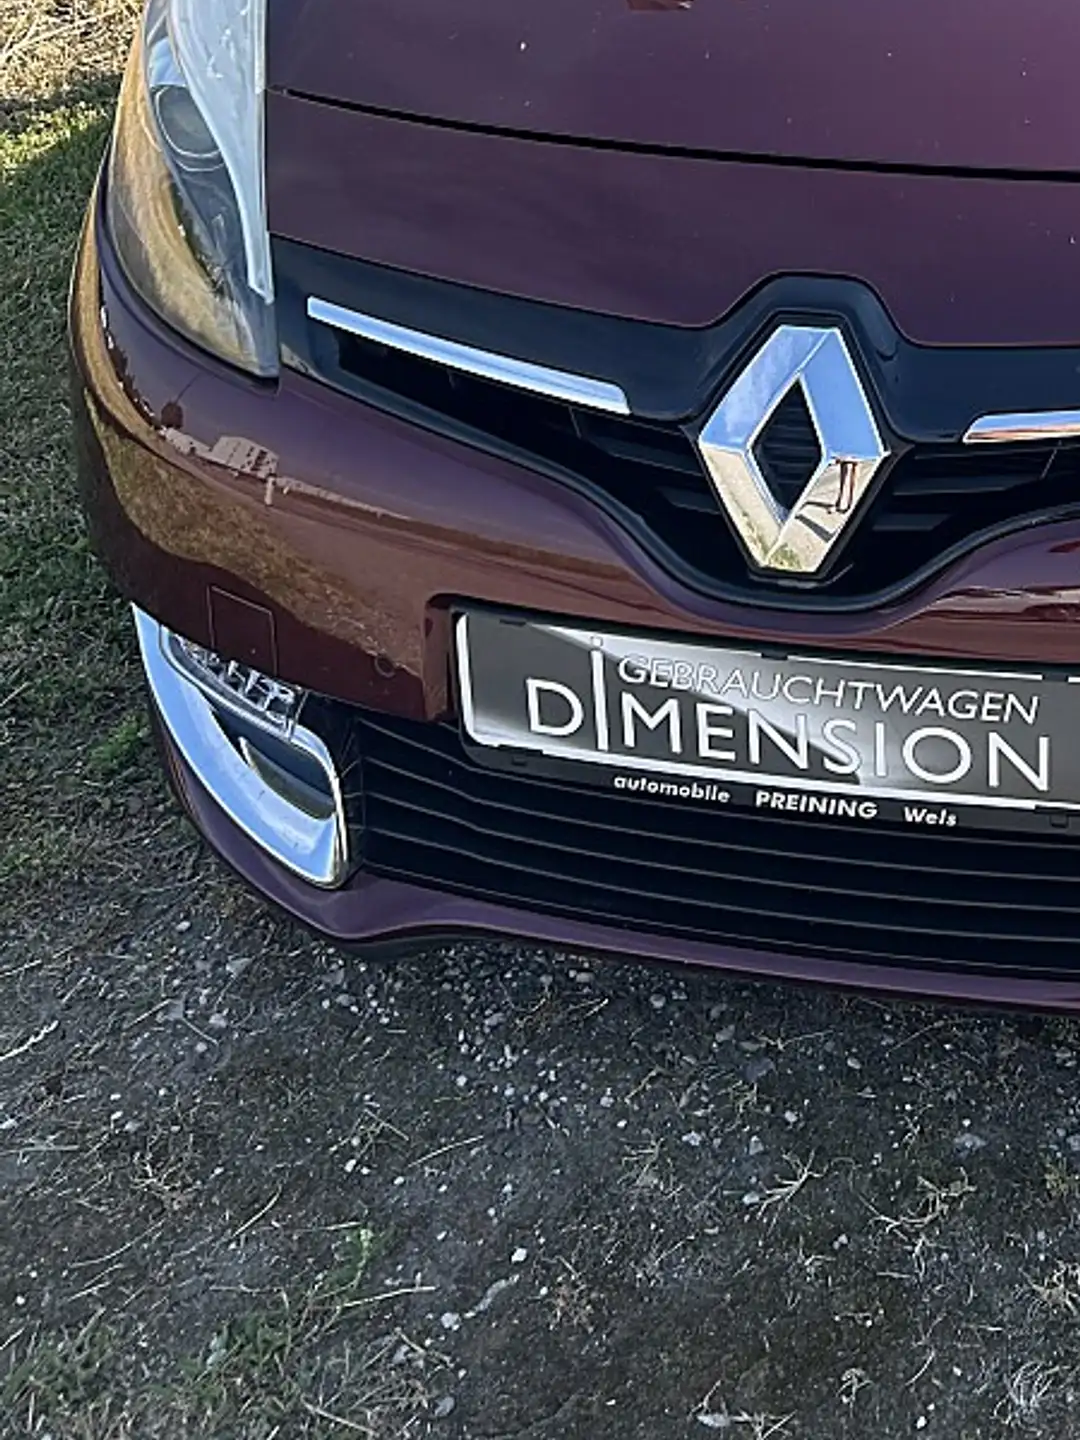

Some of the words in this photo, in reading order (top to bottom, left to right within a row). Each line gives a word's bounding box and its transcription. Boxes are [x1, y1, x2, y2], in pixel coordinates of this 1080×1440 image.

[617, 653, 1039, 725] GEBRAUCHTWAGEN
[613, 773, 731, 803] automobile
[756, 789, 878, 819] PREINING
[904, 806, 957, 827] Wels
